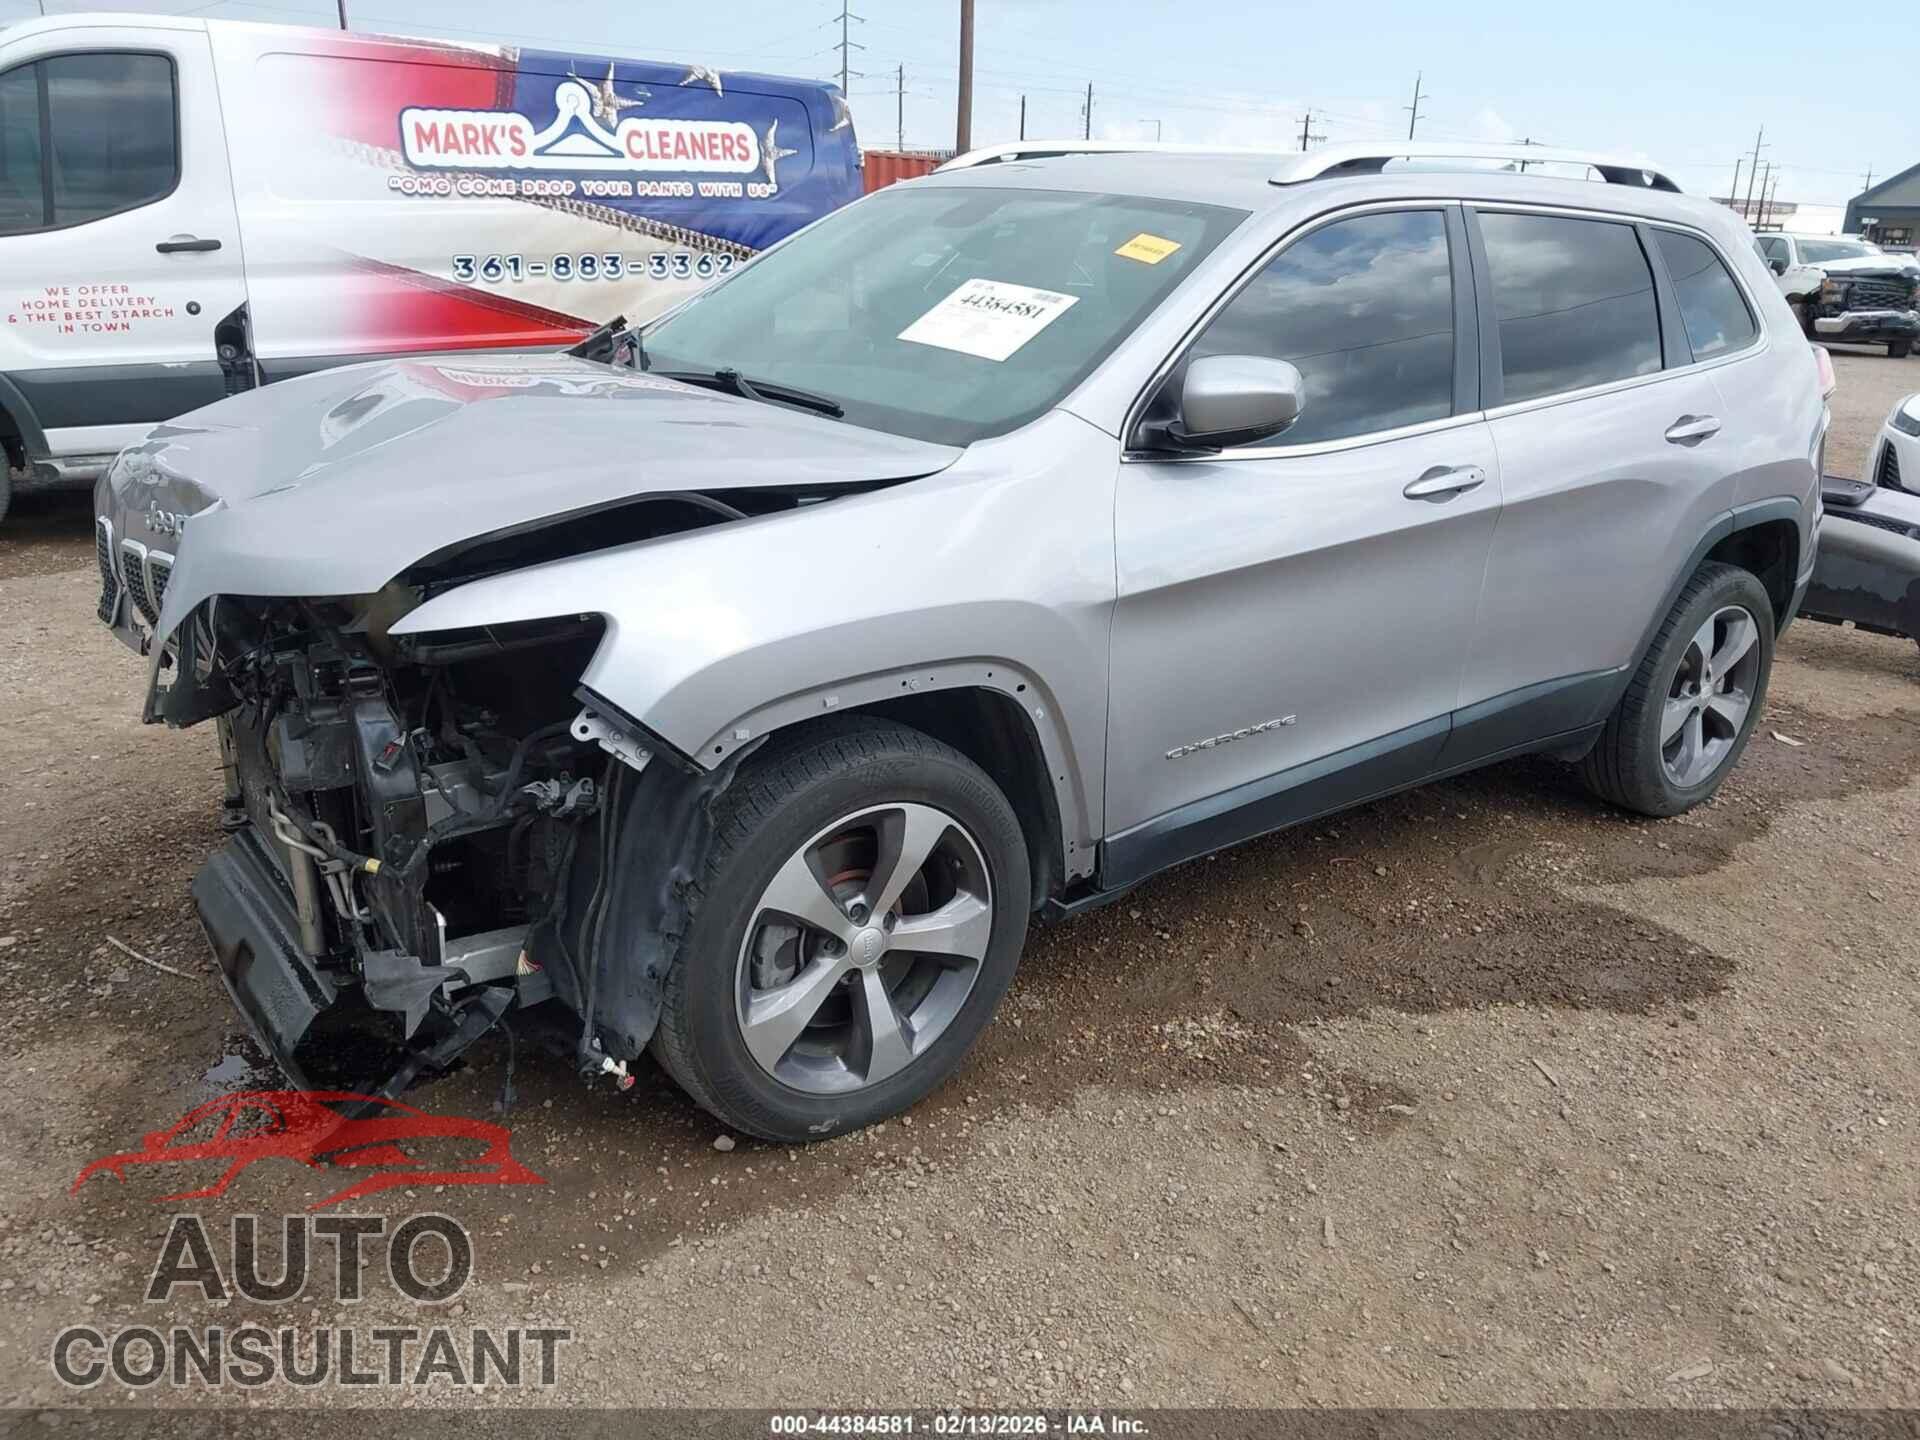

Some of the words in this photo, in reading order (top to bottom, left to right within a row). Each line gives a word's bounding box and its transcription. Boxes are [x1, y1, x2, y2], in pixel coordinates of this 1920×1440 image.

[414, 121, 527, 157] MARK'S
[625, 128, 751, 162] CLEANERS
[458, 179, 515, 194] COME
[524, 180, 574, 194] DROP
[582, 182, 632, 195] YOUR
[639, 183, 692, 196] PANTS
[699, 184, 741, 197] WITH
[454, 252, 734, 282] 361-883-3362
[45, 286, 70, 297] WE
[78, 284, 129, 296] OFFER
[22, 300, 71, 311] HOME
[79, 296, 156, 308] DELIVERY
[8, 314, 17, 324] &
[26, 312, 57, 324] THE
[64, 310, 103, 321] BEST
[111, 307, 174, 320] STARCH
[58, 324, 74, 334] IN
[82, 322, 131, 333] TOWN
